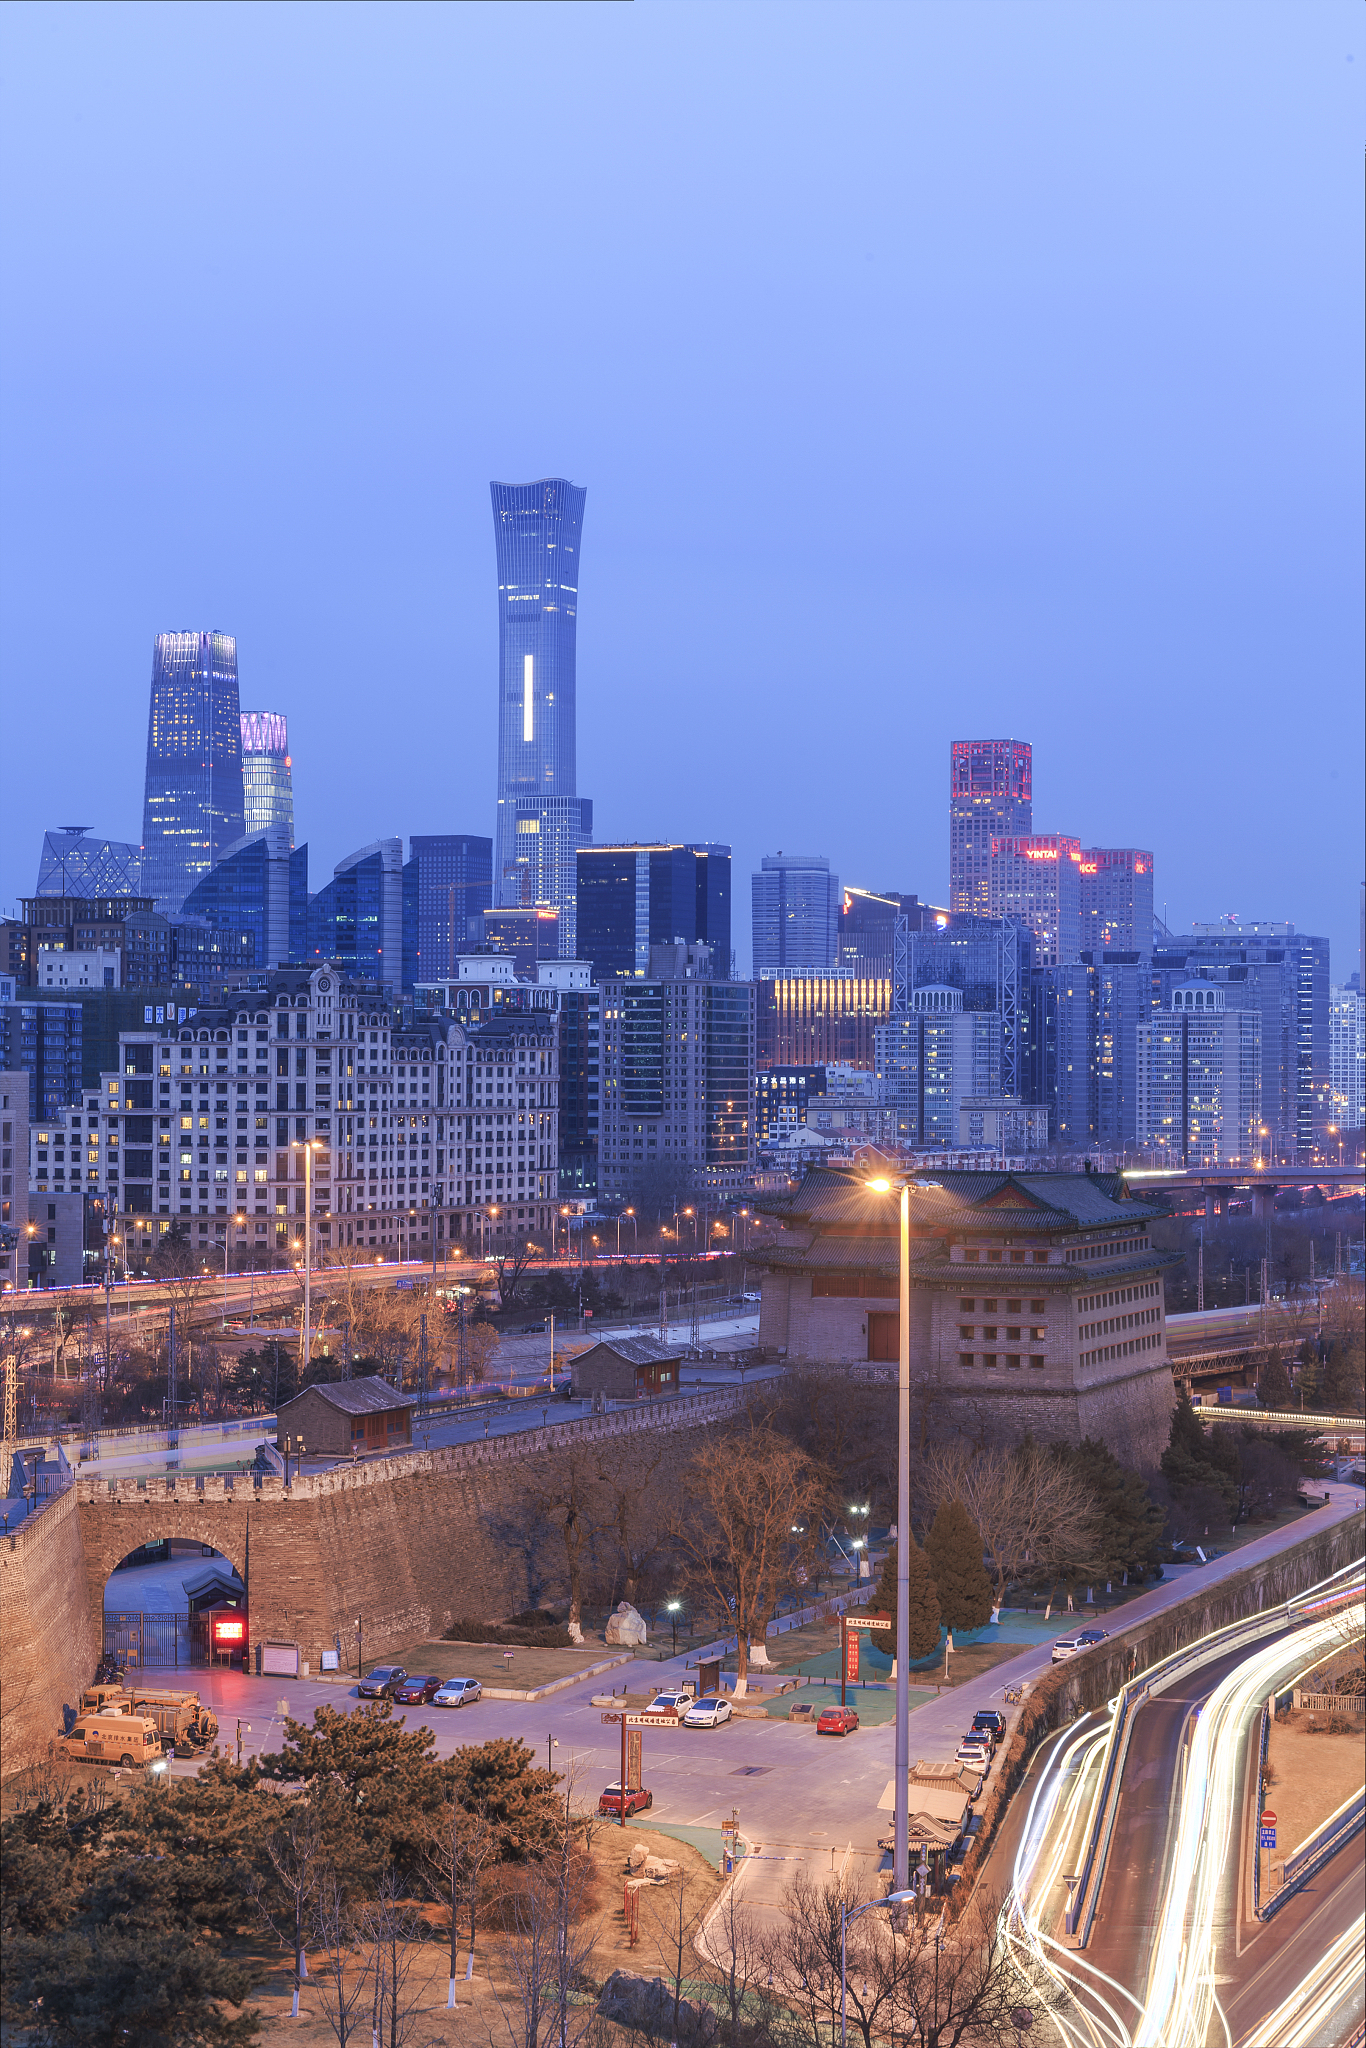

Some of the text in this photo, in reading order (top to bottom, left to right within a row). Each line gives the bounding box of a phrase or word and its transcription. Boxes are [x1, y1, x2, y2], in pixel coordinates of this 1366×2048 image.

[1026, 850, 1057, 859] YINTAI
[102, 1733, 139, 1743] 北京排水集团
